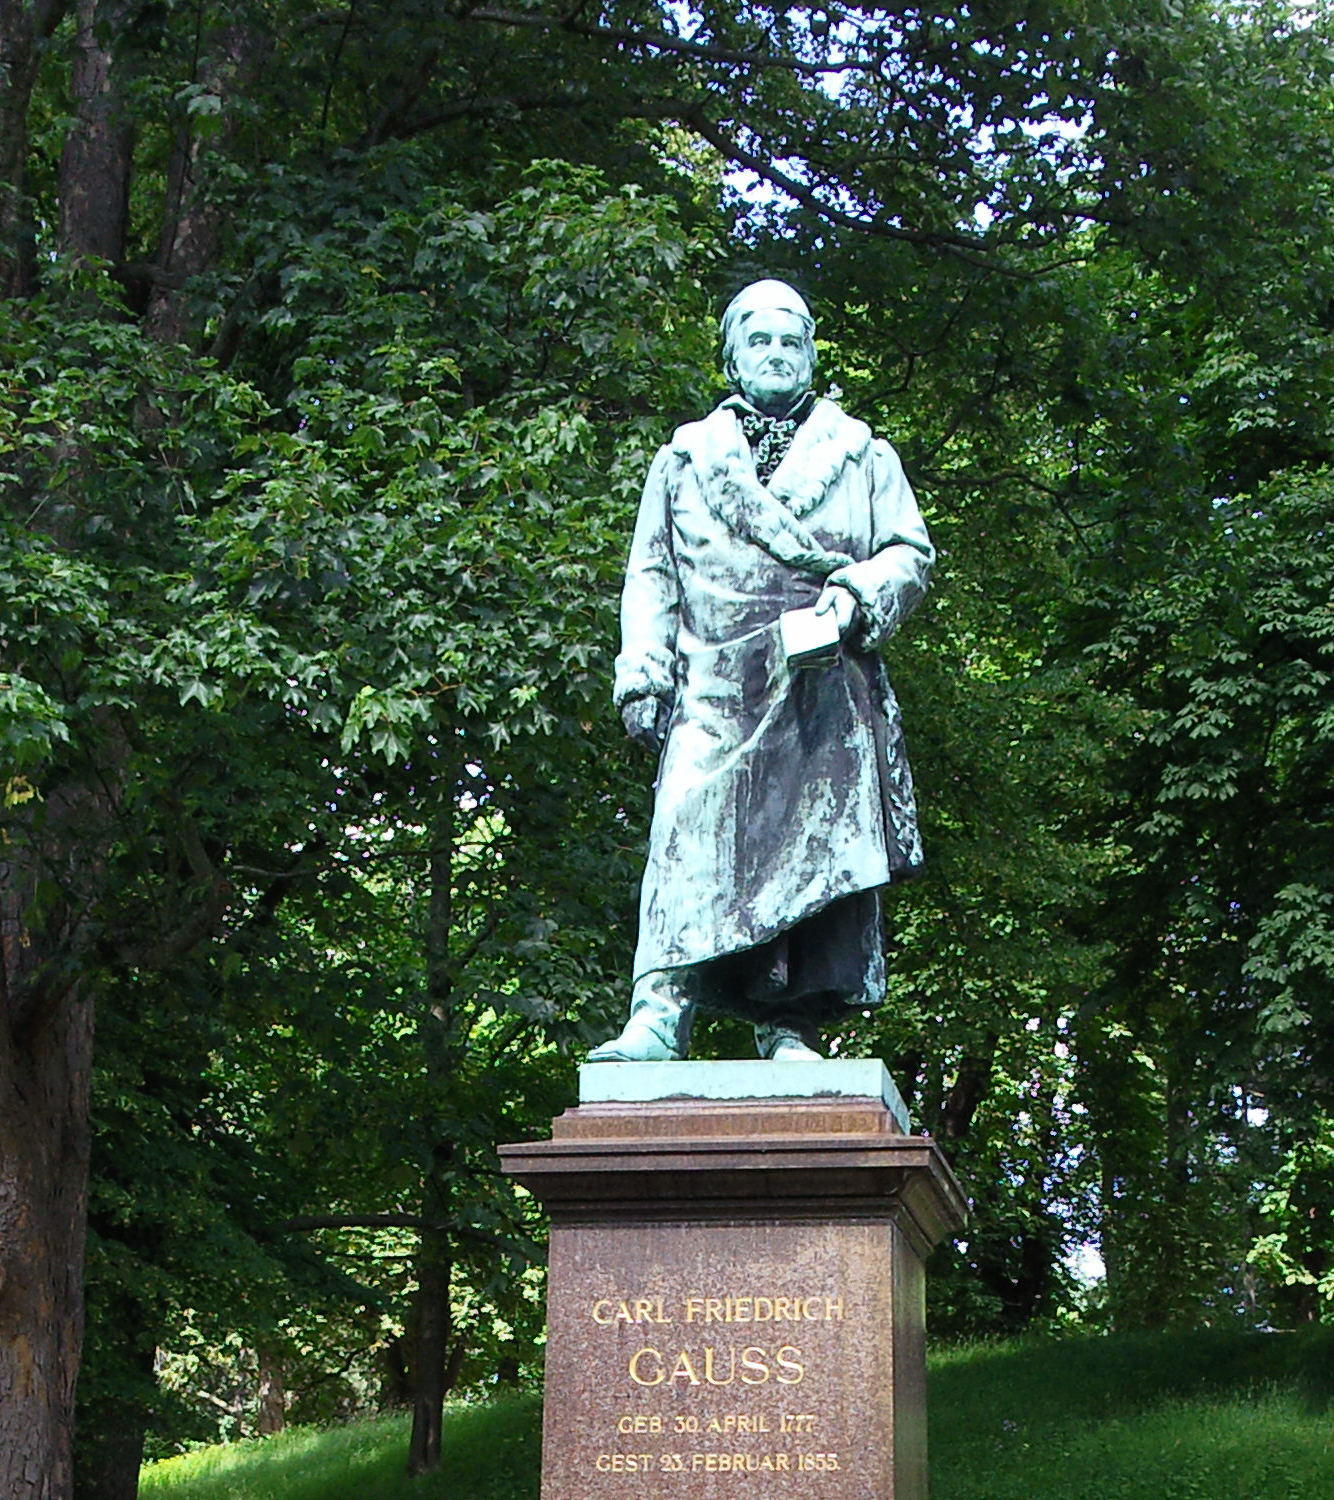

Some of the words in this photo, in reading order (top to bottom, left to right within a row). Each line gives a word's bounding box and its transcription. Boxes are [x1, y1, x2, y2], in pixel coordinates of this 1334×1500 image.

[593, 1298, 671, 1325] CARL
[686, 1296, 844, 1323] FRIEDRICH
[629, 1346, 805, 1387] GAUSS
[706, 1414, 771, 1434] APRIL
[691, 1453, 791, 1473] FEBRUAR
